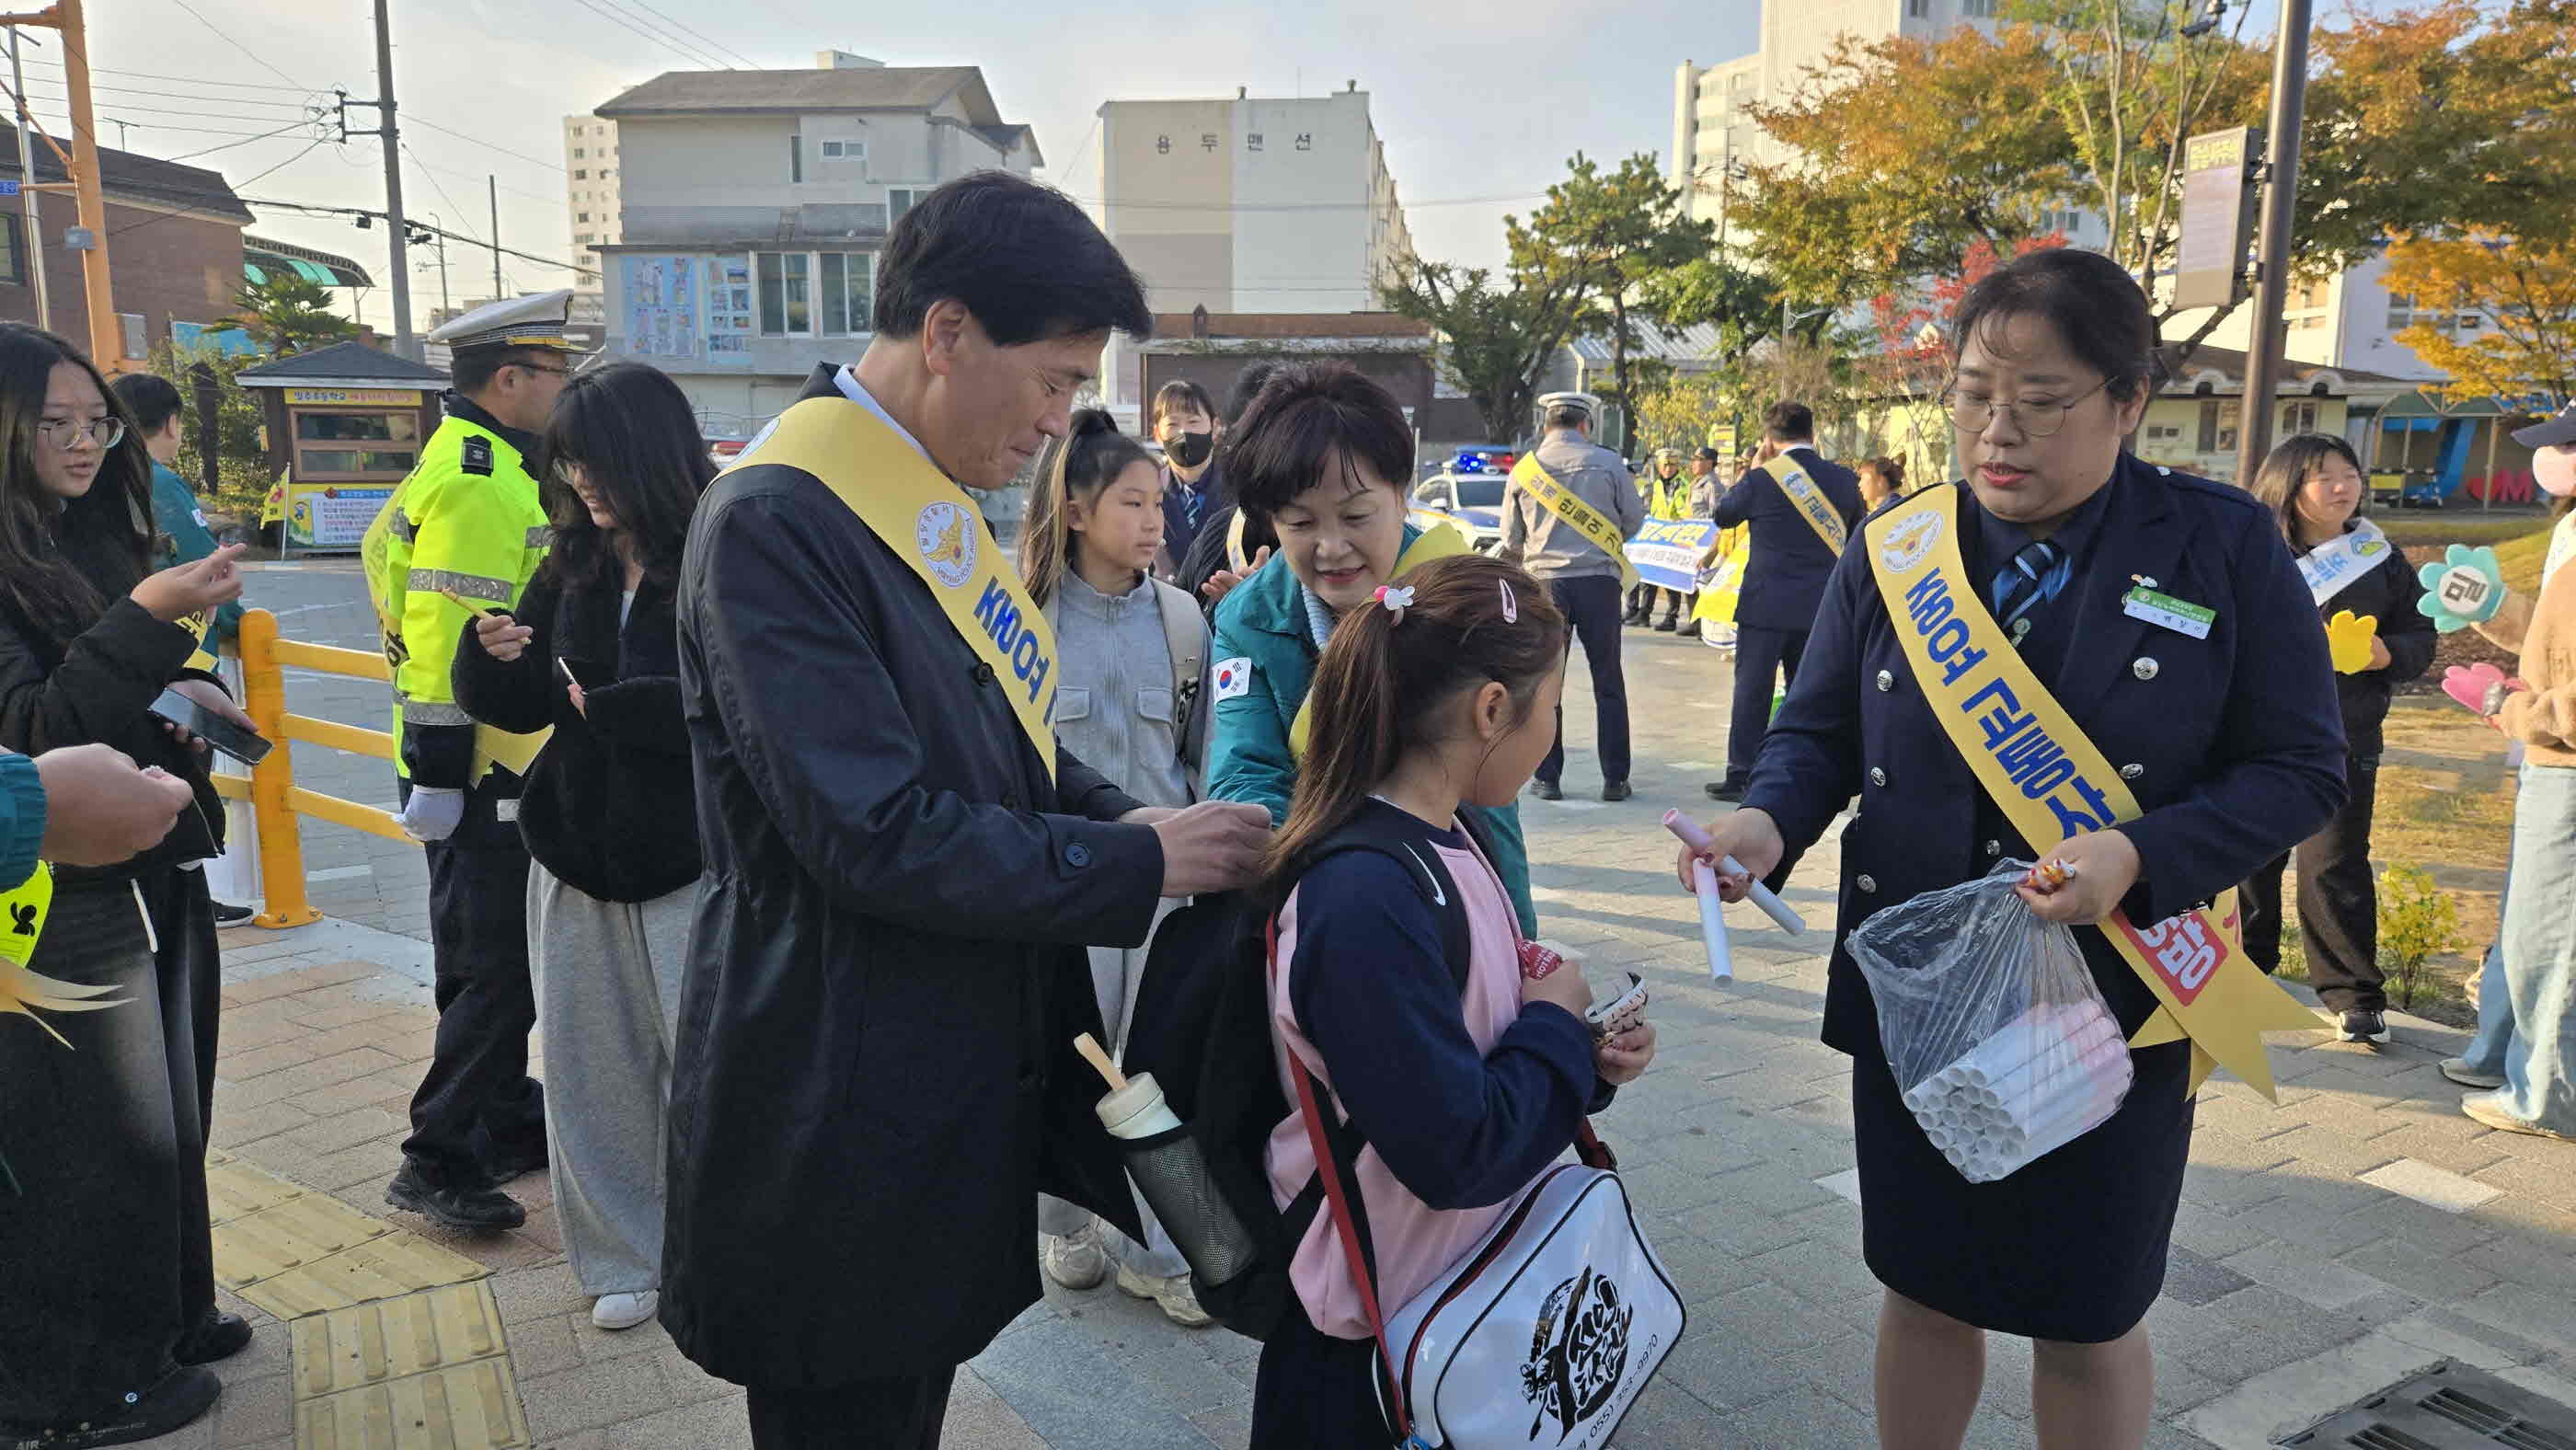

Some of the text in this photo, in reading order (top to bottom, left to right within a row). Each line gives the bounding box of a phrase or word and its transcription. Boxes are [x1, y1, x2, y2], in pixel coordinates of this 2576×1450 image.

[1156, 133, 1311, 155] 용두맨션
[1905, 567, 1987, 687] 중요
[1961, 675, 2118, 839] 교통사
